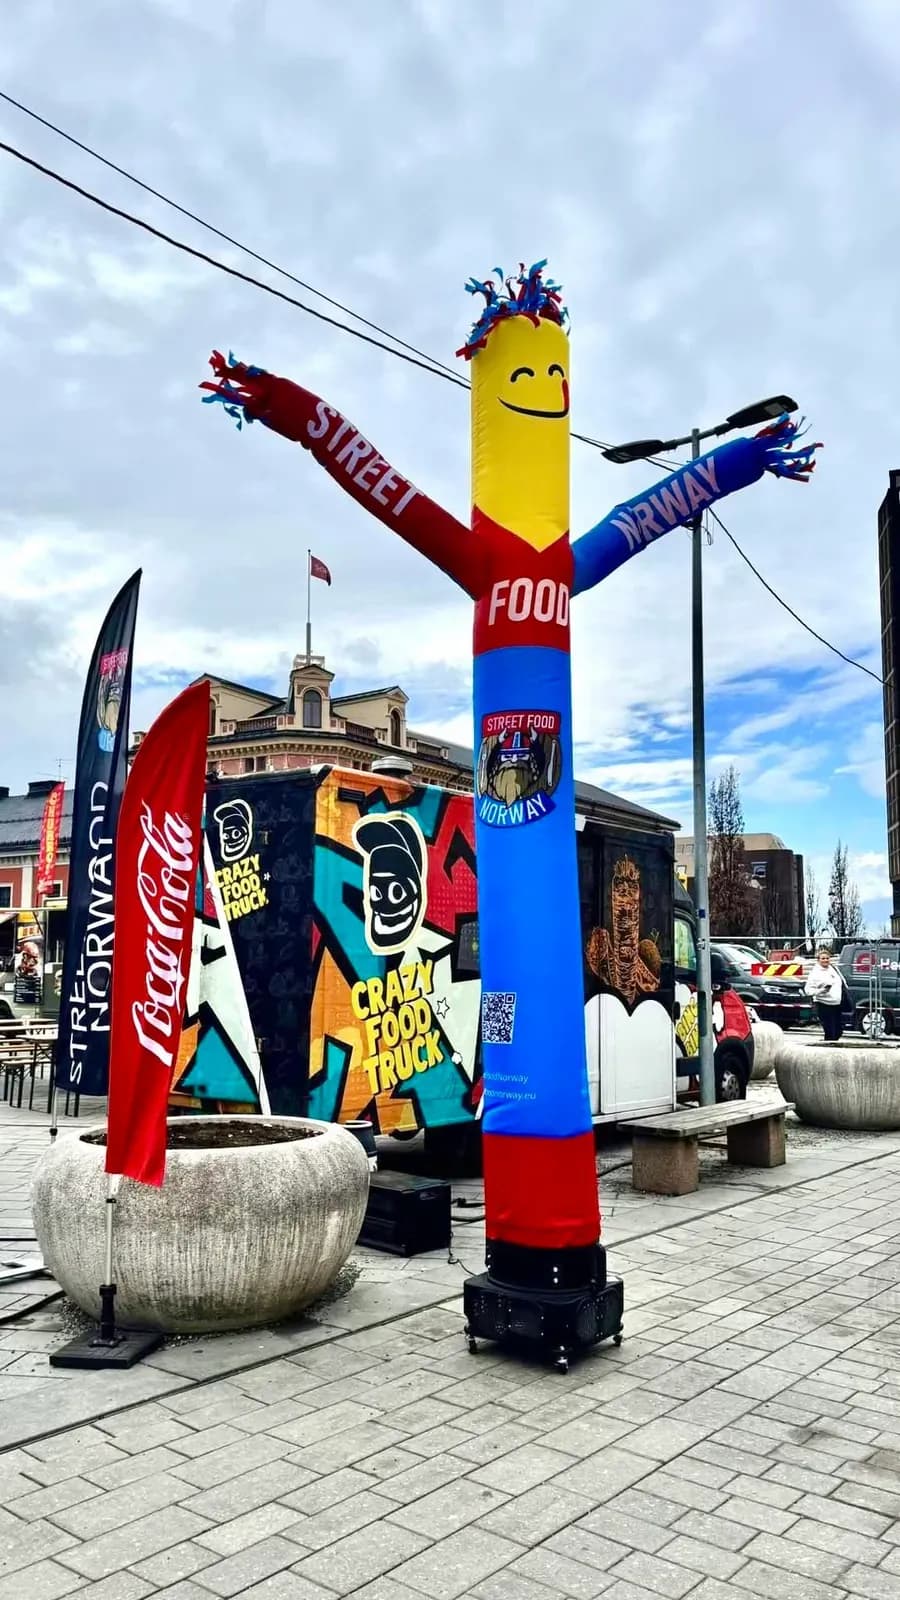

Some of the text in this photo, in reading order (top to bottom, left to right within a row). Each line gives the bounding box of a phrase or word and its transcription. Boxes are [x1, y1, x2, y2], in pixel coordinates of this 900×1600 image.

[307, 401, 425, 516] STREET
[487, 577, 569, 627] FOOD
[487, 714, 555, 732] STREET FOOD
[479, 793, 547, 825] NORWAY
[214, 853, 260, 888] CRAZY
[222, 873, 261, 904] FOOD
[223, 887, 267, 922] TRUCK
[131, 799, 194, 1067] Coca-Cola
[880, 957, 900, 971] He
[351, 959, 433, 1020] CRAZY
[365, 997, 432, 1056] FOOD
[362, 1030, 444, 1095] TRUCK
